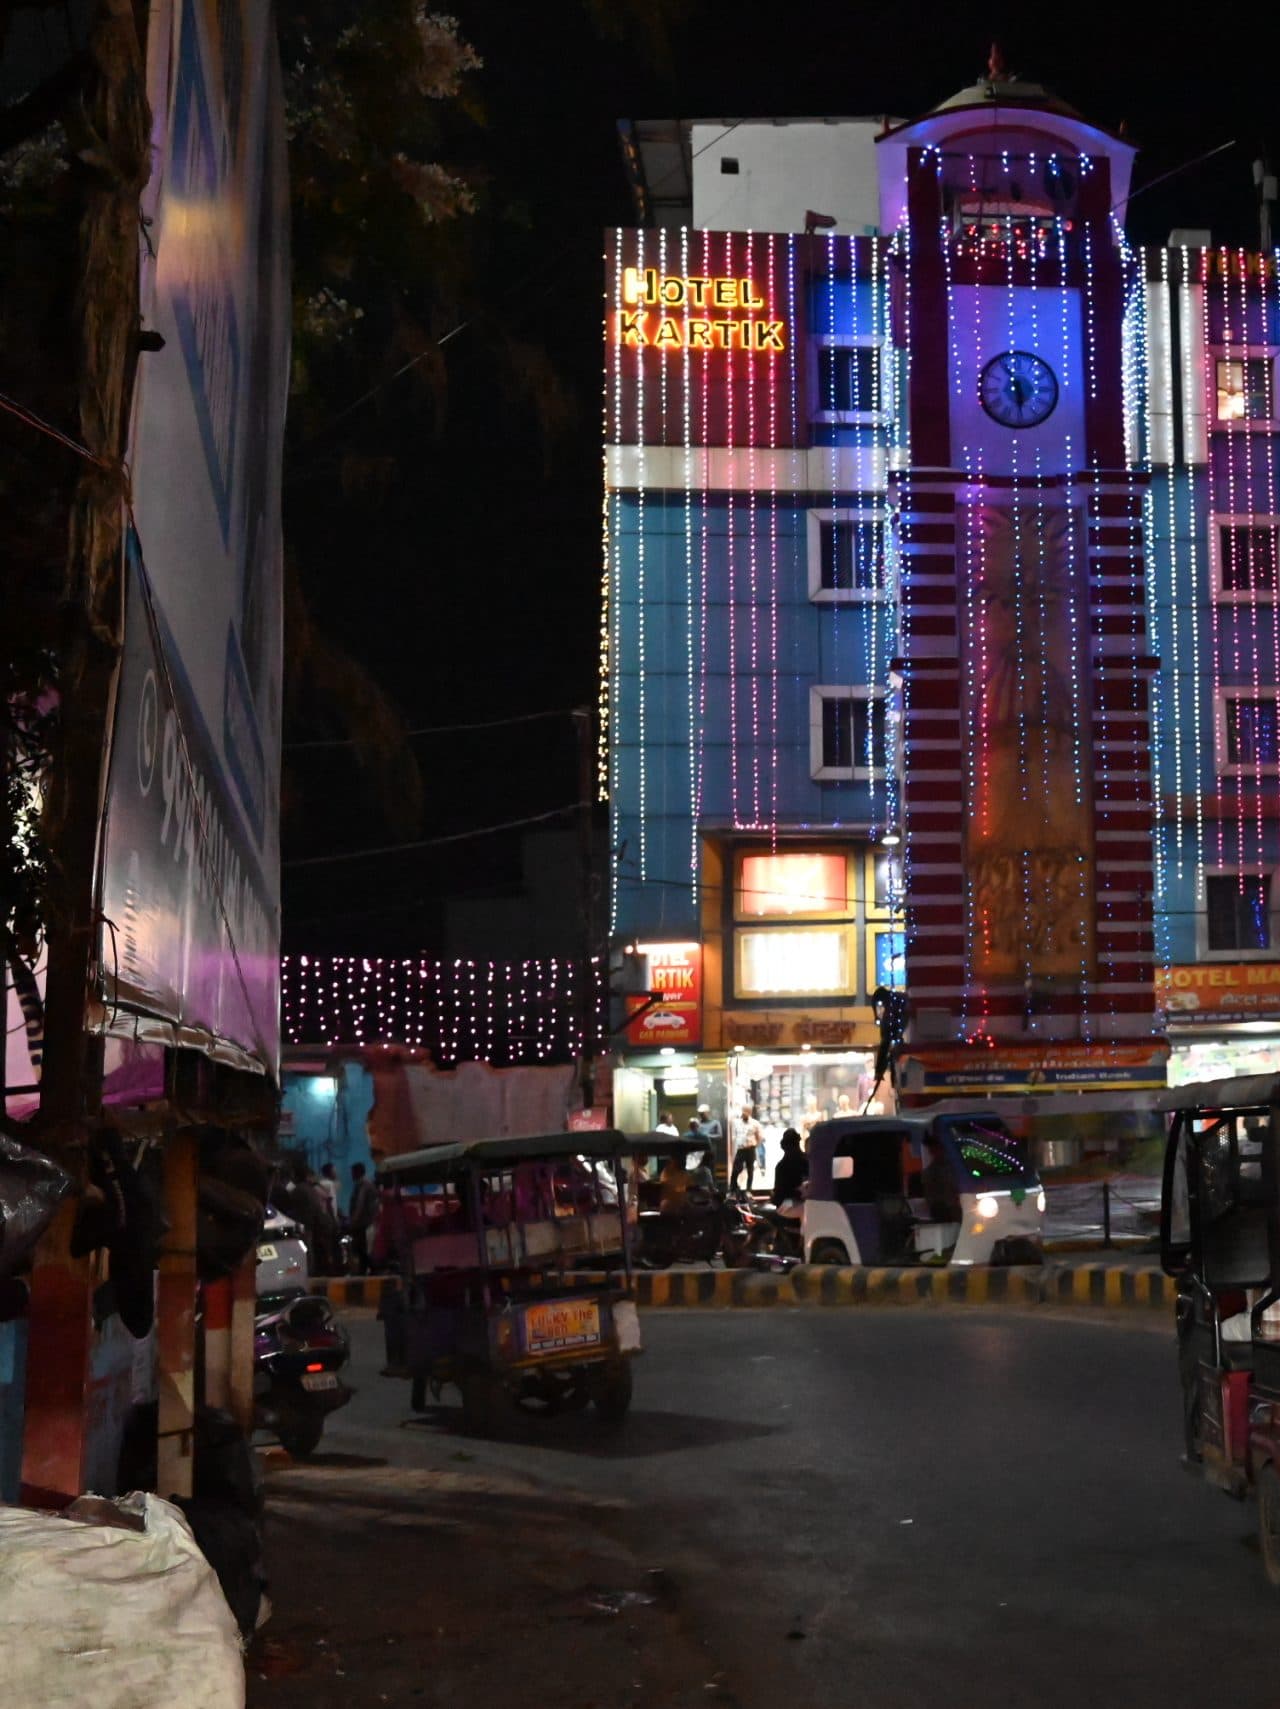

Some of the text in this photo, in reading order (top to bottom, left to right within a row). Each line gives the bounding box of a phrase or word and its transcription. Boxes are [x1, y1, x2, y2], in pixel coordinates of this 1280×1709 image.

[624, 267, 763, 308] HOTEL
[618, 310, 784, 350] KARTIK
[1155, 968, 1241, 988] HOTEL
